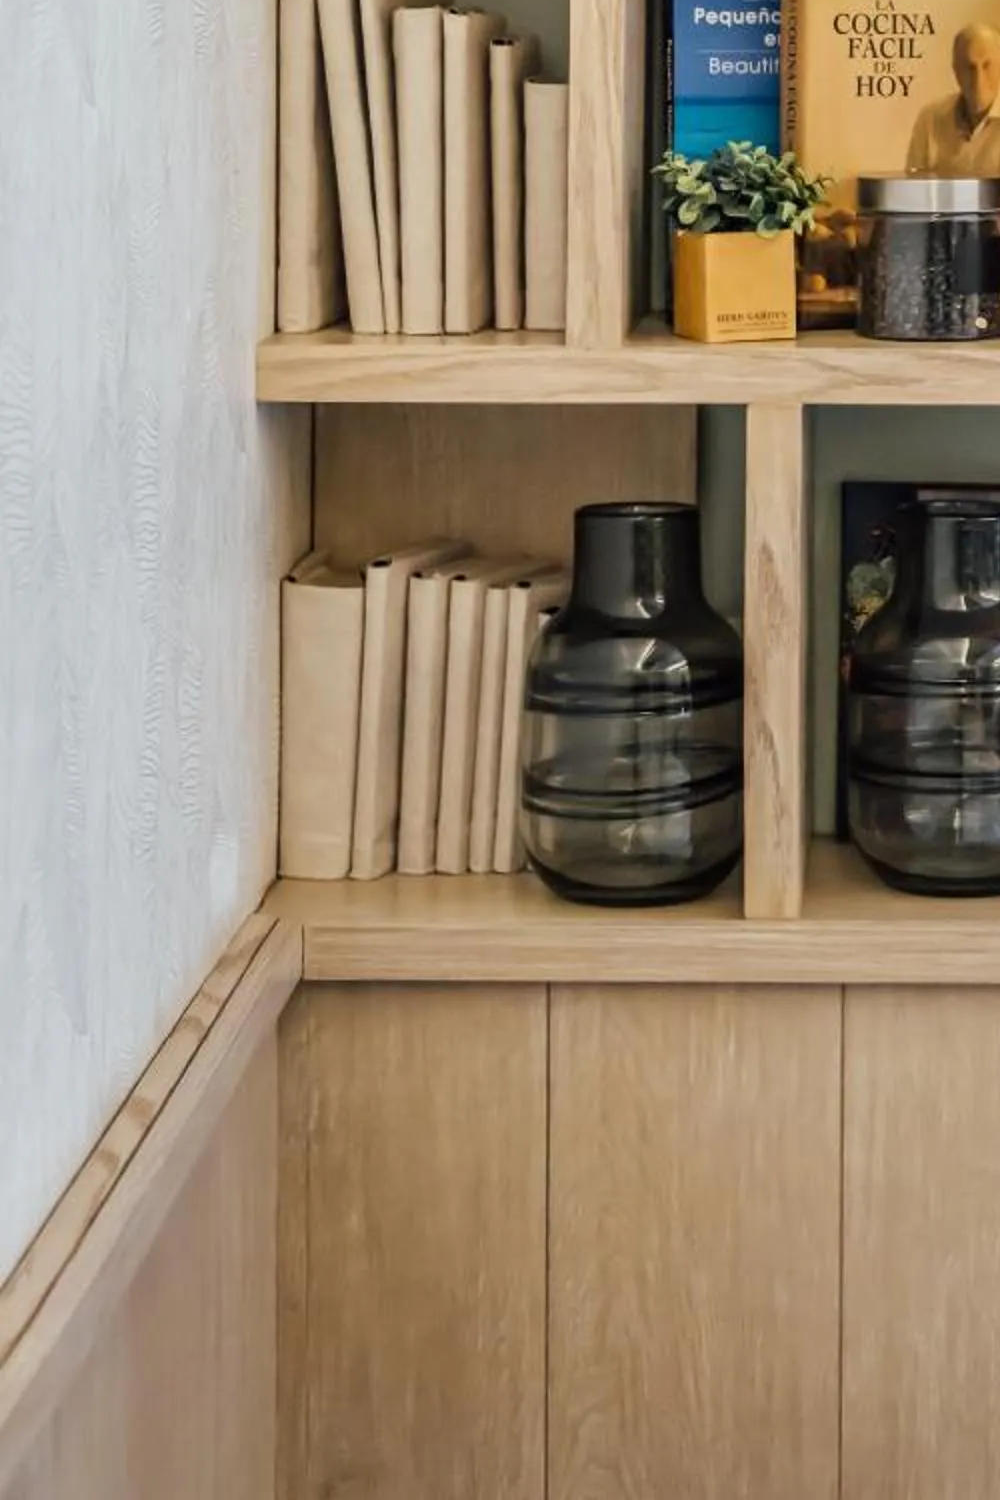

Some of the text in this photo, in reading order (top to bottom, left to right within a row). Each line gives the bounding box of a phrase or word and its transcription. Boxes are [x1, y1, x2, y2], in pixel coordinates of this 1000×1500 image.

[833, 13, 935, 35] COCINA
[848, 33, 922, 59] FÁCIL
[874, 61, 896, 74] DE
[856, 75, 914, 97] HOY
